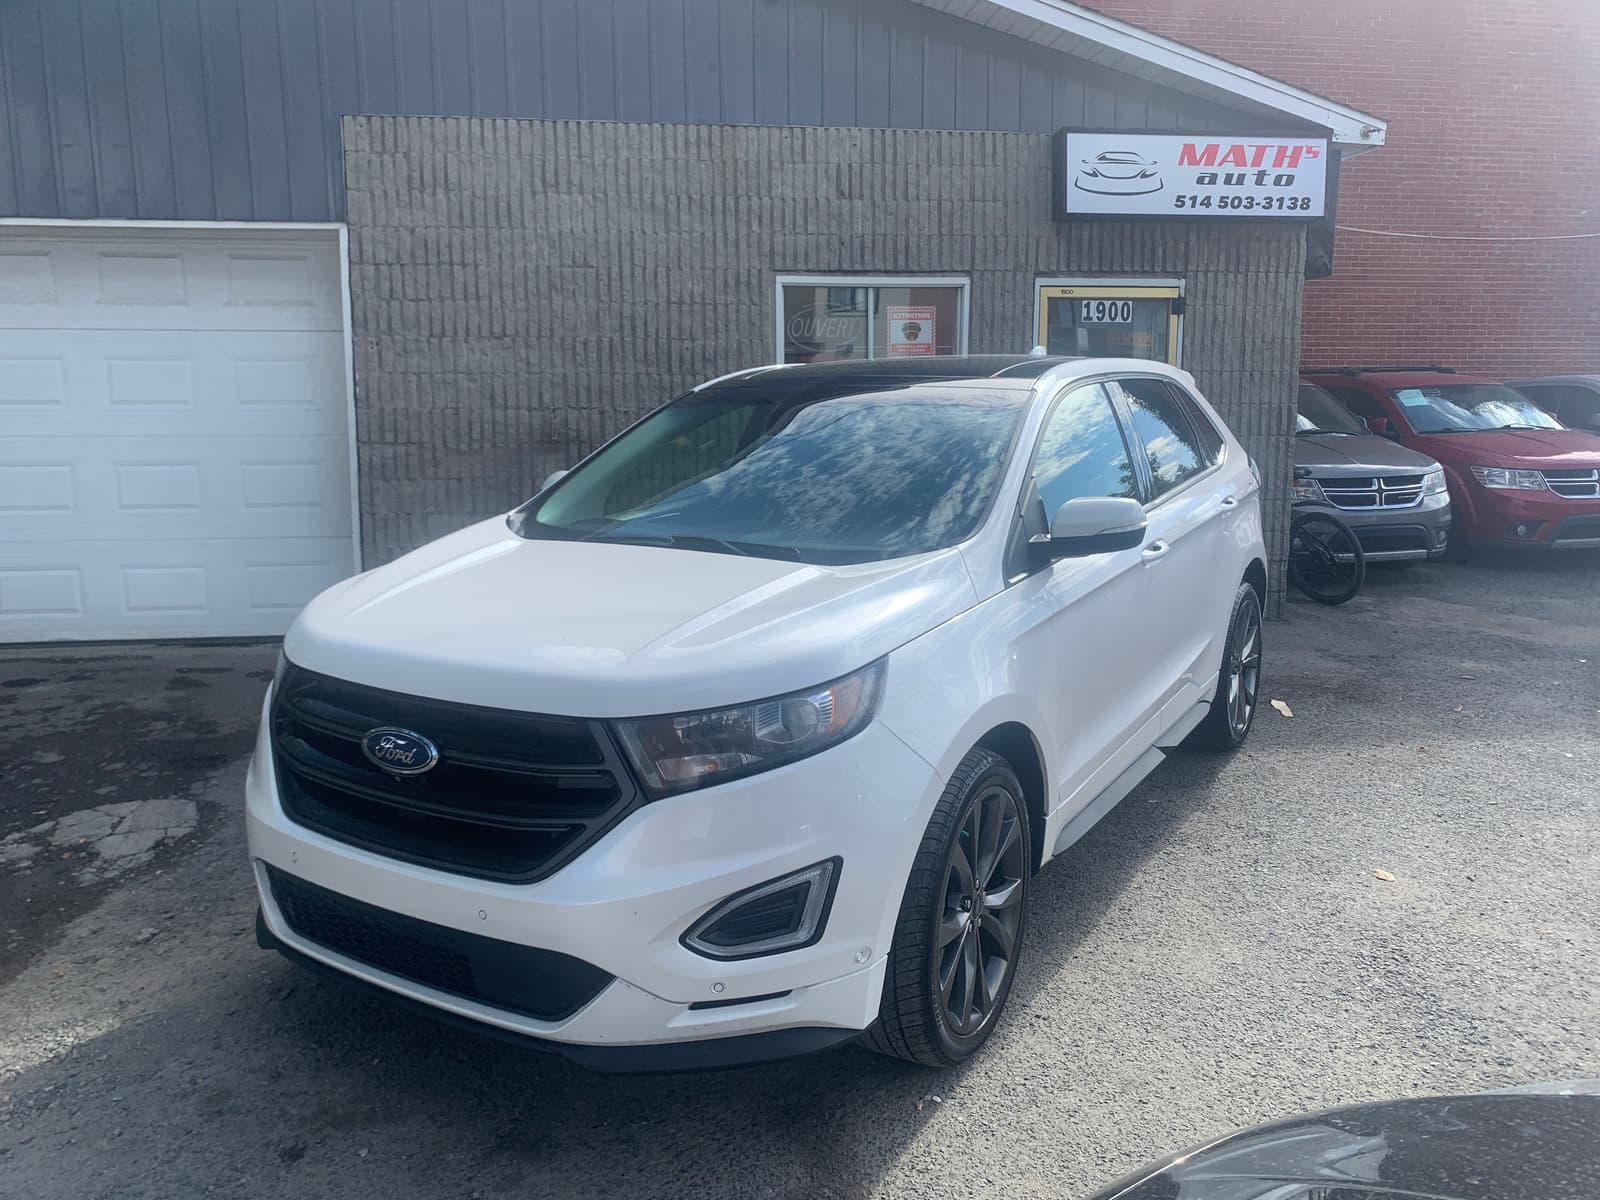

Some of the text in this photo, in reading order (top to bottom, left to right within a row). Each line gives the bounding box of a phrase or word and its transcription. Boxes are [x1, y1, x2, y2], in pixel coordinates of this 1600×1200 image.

[1196, 169, 1296, 187] auto
[1174, 194, 1312, 211] 514 503-3138
[1083, 301, 1131, 321] 1900
[375, 735, 417, 764] Ford
